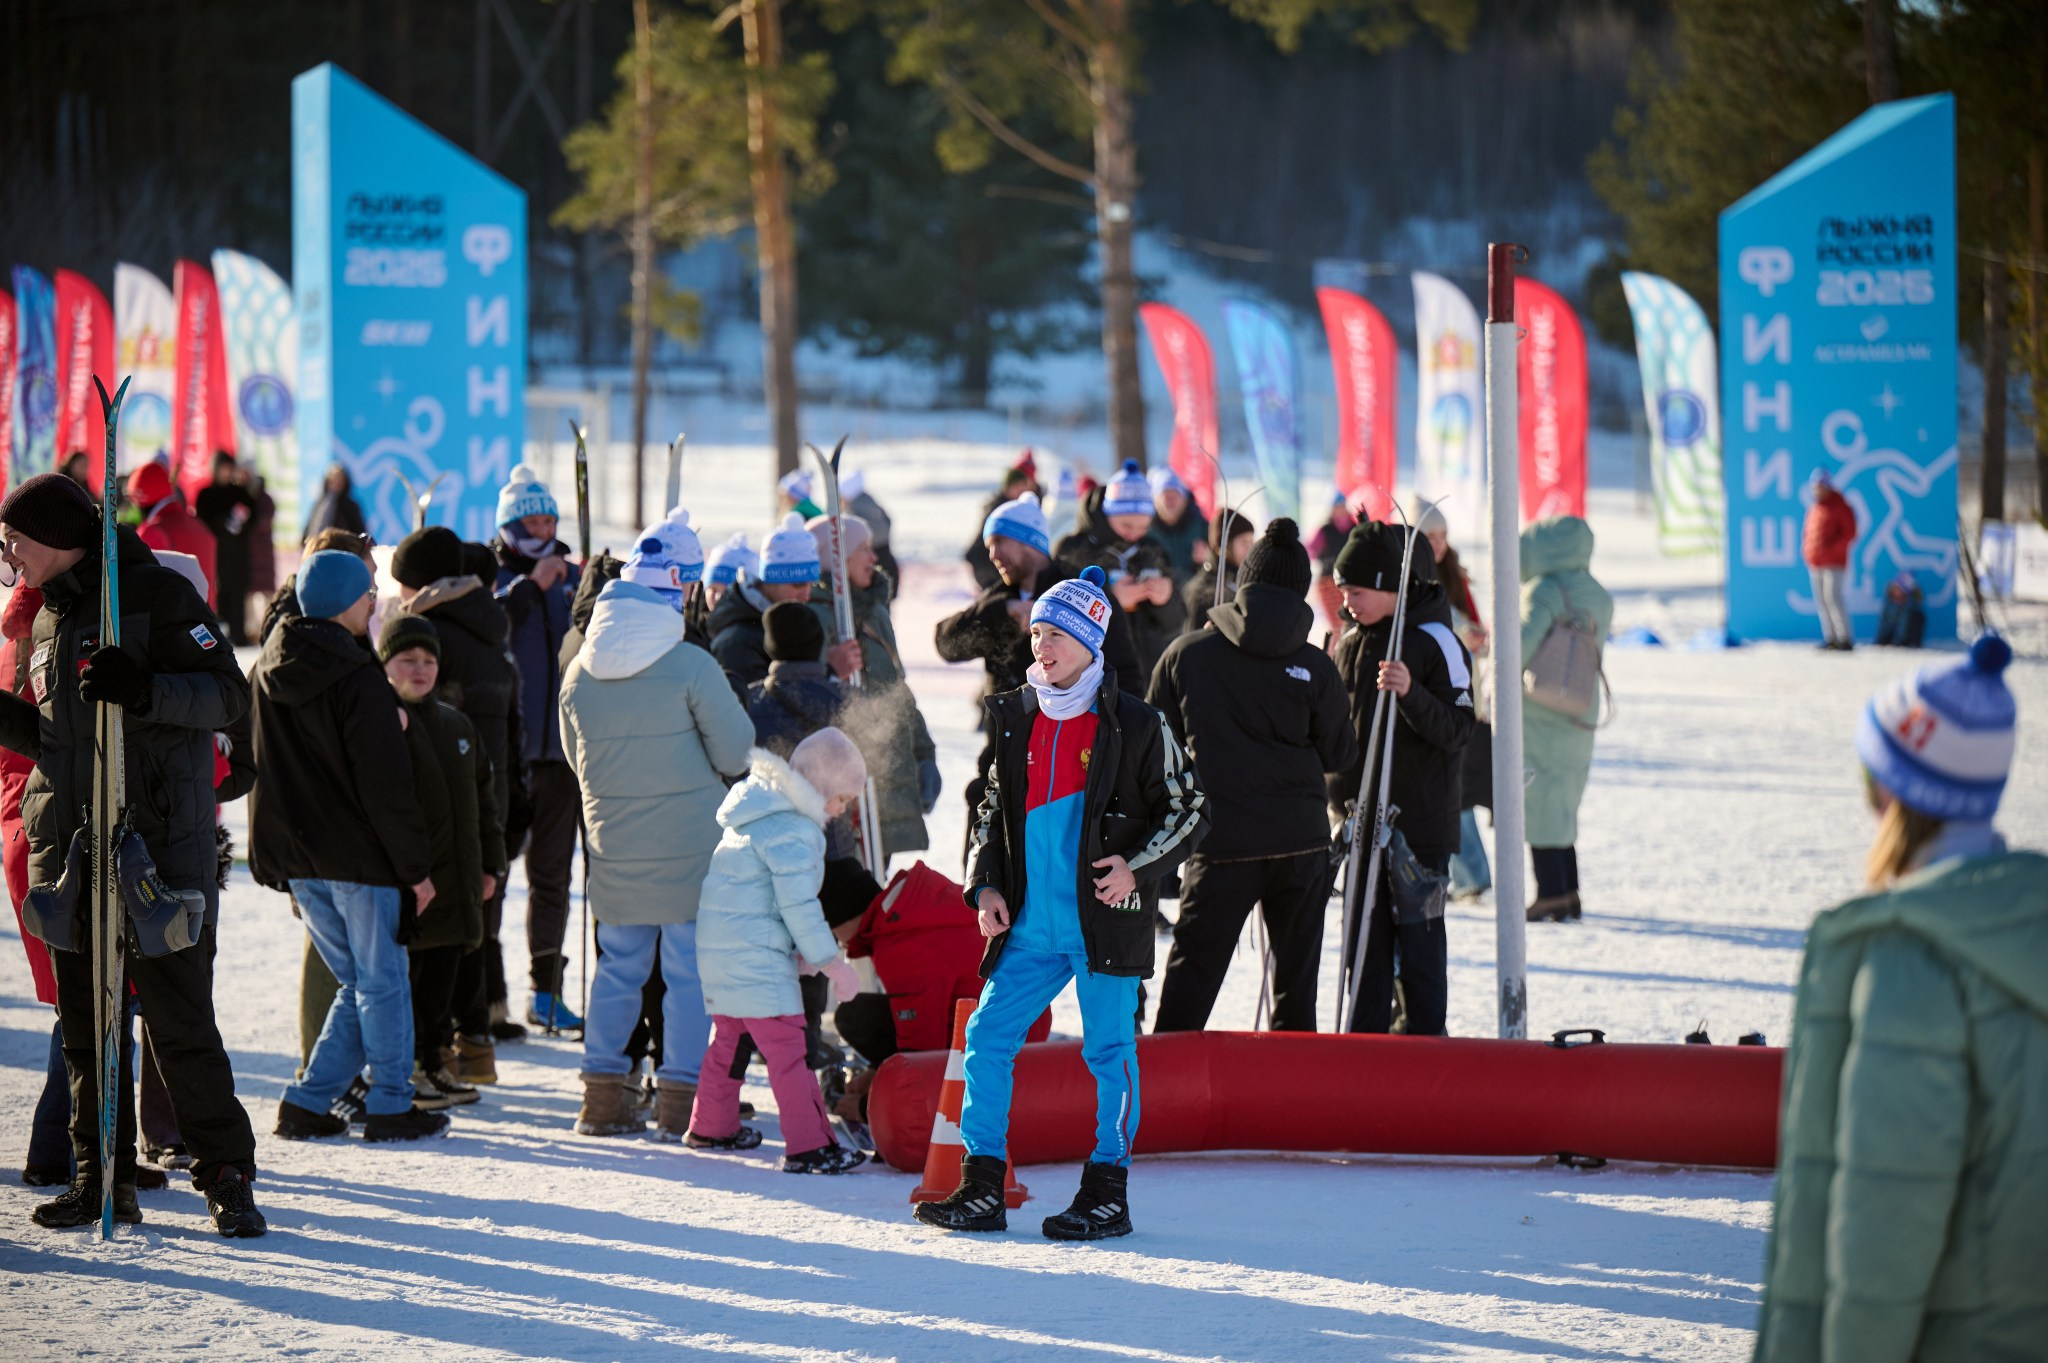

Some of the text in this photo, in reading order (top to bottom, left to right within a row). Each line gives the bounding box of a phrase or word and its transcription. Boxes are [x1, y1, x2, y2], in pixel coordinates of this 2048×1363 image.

[345, 248, 447, 287] 2025
[1816, 269, 1935, 307] 2025
[1739, 247, 1796, 566] ФИНИШ
[193, 627, 207, 638] PLX
[1056, 614, 1089, 639] РОССИИ
[1058, 610, 1092, 633] ЛЫЖНЯ
[140, 879, 155, 900] spine
